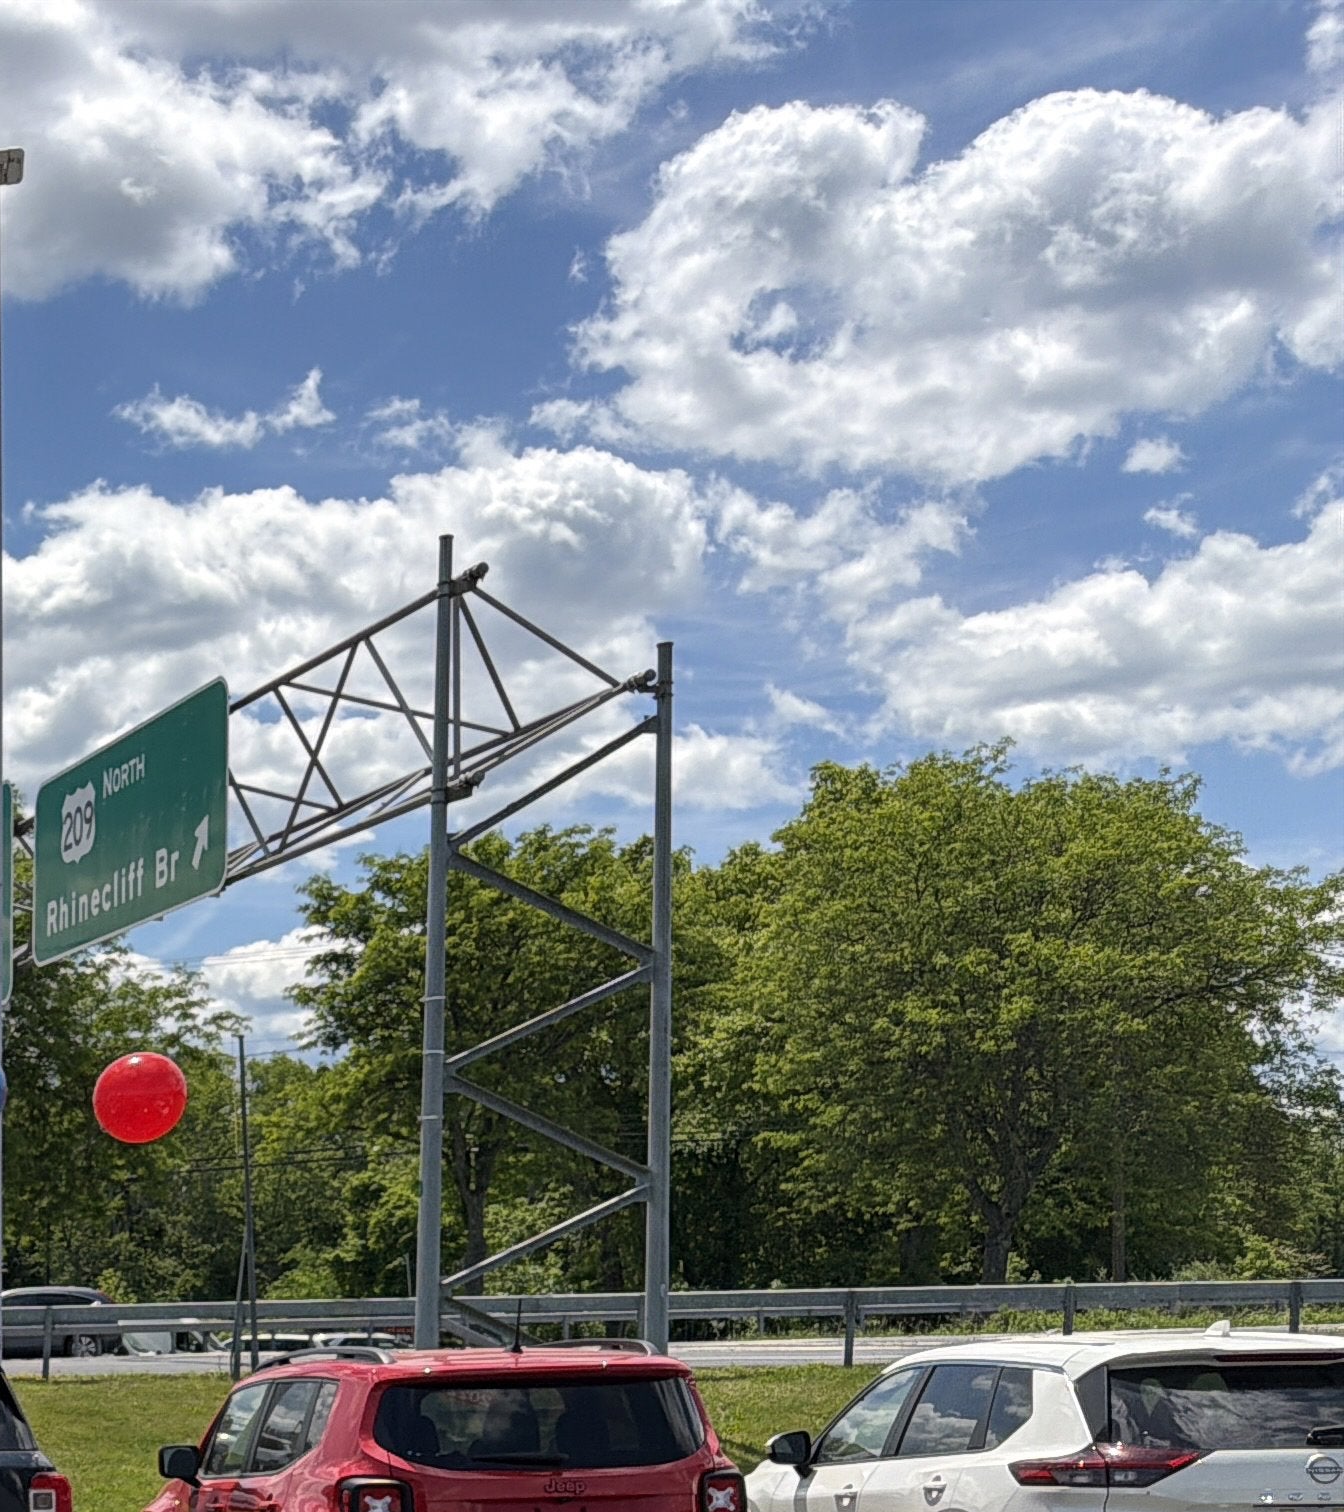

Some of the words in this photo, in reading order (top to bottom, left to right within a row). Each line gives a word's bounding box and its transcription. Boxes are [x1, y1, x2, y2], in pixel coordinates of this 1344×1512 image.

[102, 753, 146, 799] NORTH
[63, 800, 94, 852] 209
[46, 857, 144, 937] Rhinecliff
[155, 848, 180, 888] Br
[543, 1478, 586, 1495] Jeep
